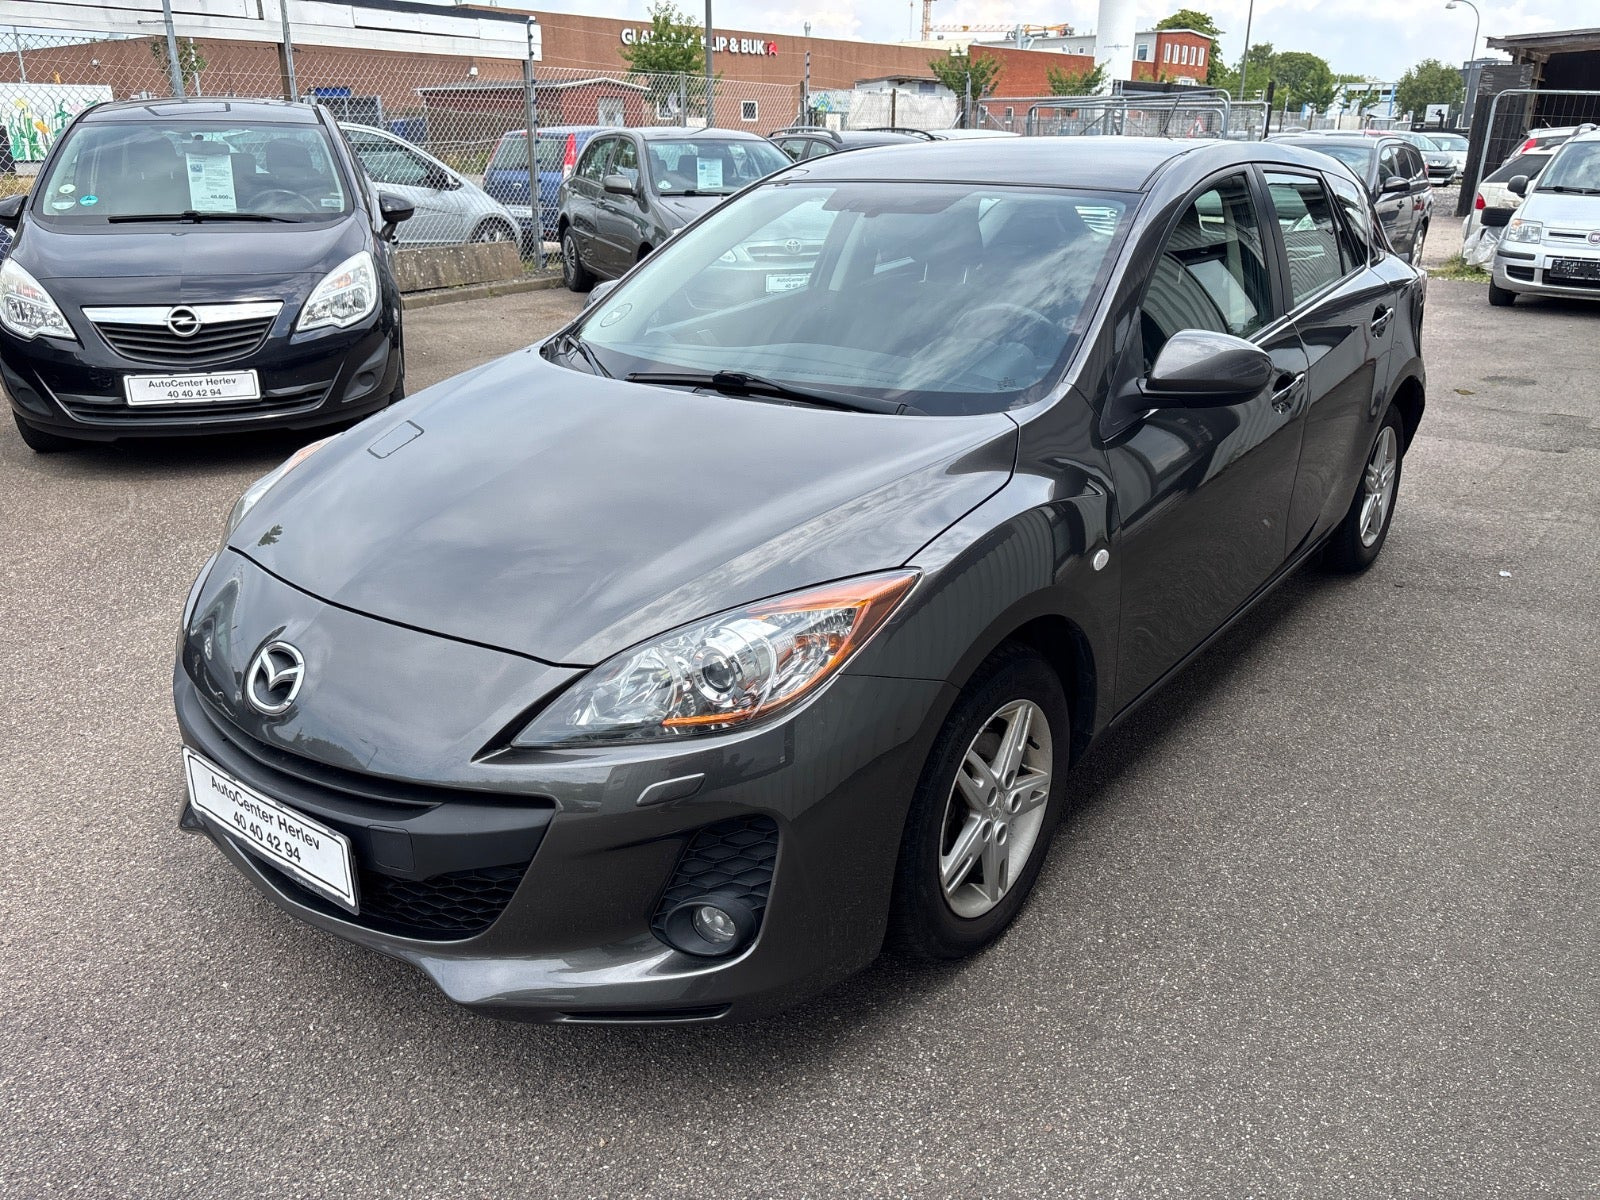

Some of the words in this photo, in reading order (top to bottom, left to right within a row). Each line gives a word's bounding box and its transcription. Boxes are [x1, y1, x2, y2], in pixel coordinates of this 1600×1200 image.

[729, 37, 739, 53] &
[741, 39, 765, 56] BUK
[148, 379, 203, 388] AutoCenter
[205, 377, 236, 386] Herlev
[167, 390, 179, 398] 40
[181, 389, 193, 397] 40
[196, 389, 208, 397] 42
[209, 388, 222, 396] 94
[211, 775, 274, 826] AutoCenter
[277, 814, 320, 850] Herlev
[233, 811, 247, 830] 40
[249, 822, 263, 841] 40
[266, 833, 282, 852] 42
[284, 841, 302, 863] 94
